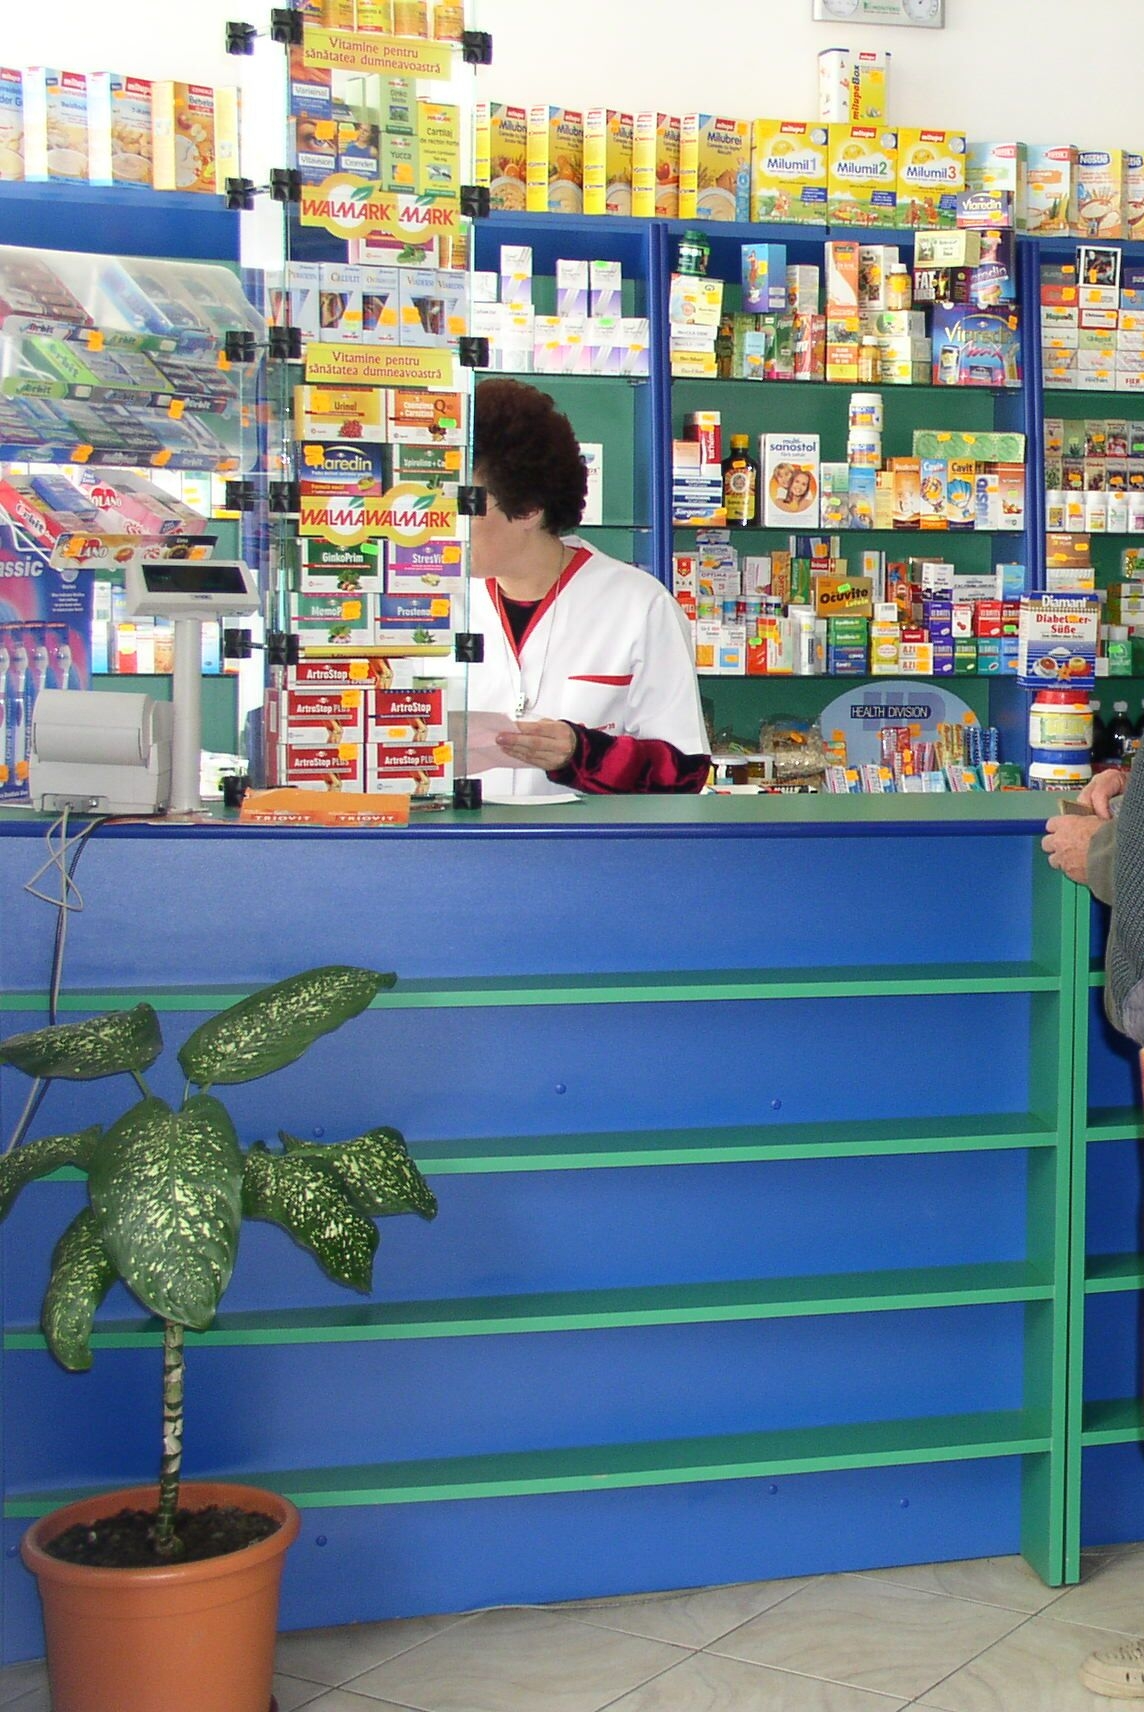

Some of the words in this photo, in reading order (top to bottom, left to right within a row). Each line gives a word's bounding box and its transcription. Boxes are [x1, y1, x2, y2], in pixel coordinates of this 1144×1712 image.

[329, 37, 379, 54] Vitamine
[383, 45, 419, 59] pentru
[305, 49, 356, 64] sănătatea
[361, 54, 441, 74] dumneavoastră
[708, 132, 742, 145] Milubrei
[767, 158, 809, 169] Milumil
[837, 162, 878, 174] Milumil
[907, 167, 947, 178] Milumil
[302, 199, 392, 221] WALMARK
[398, 206, 455, 225] MARK
[915, 271, 936, 289] FAT
[332, 351, 381, 364] Vitamine
[385, 357, 420, 367] pentru
[308, 364, 358, 376] sănătatea
[363, 366, 442, 379] dumneavoastră
[770, 443, 816, 451] sanostol
[314, 456, 372, 471] aredin
[951, 463, 972, 472] Cavit
[92, 494, 122, 508] OLANO
[301, 509, 365, 526] WALMA
[364, 511, 450, 528] WALMARK
[412, 554, 444, 564] StresVi
[820, 588, 868, 604] Ocuvite
[1042, 595, 1087, 607] Diamant
[312, 607, 343, 617] MemoP
[1036, 614, 1091, 623] Diabeter-
[1051, 624, 1076, 633] Süße
[307, 669, 348, 680] ArtroStop
[297, 704, 332, 713] ArtroStop
[391, 702, 431, 713] ArtroStop
[852, 706, 884, 718] HEALTH
[888, 706, 928, 718] DIVISION
[294, 758, 331, 767] ArtroStop
[384, 755, 420, 765] ArtroStop
[420, 755, 434, 764] PLU
